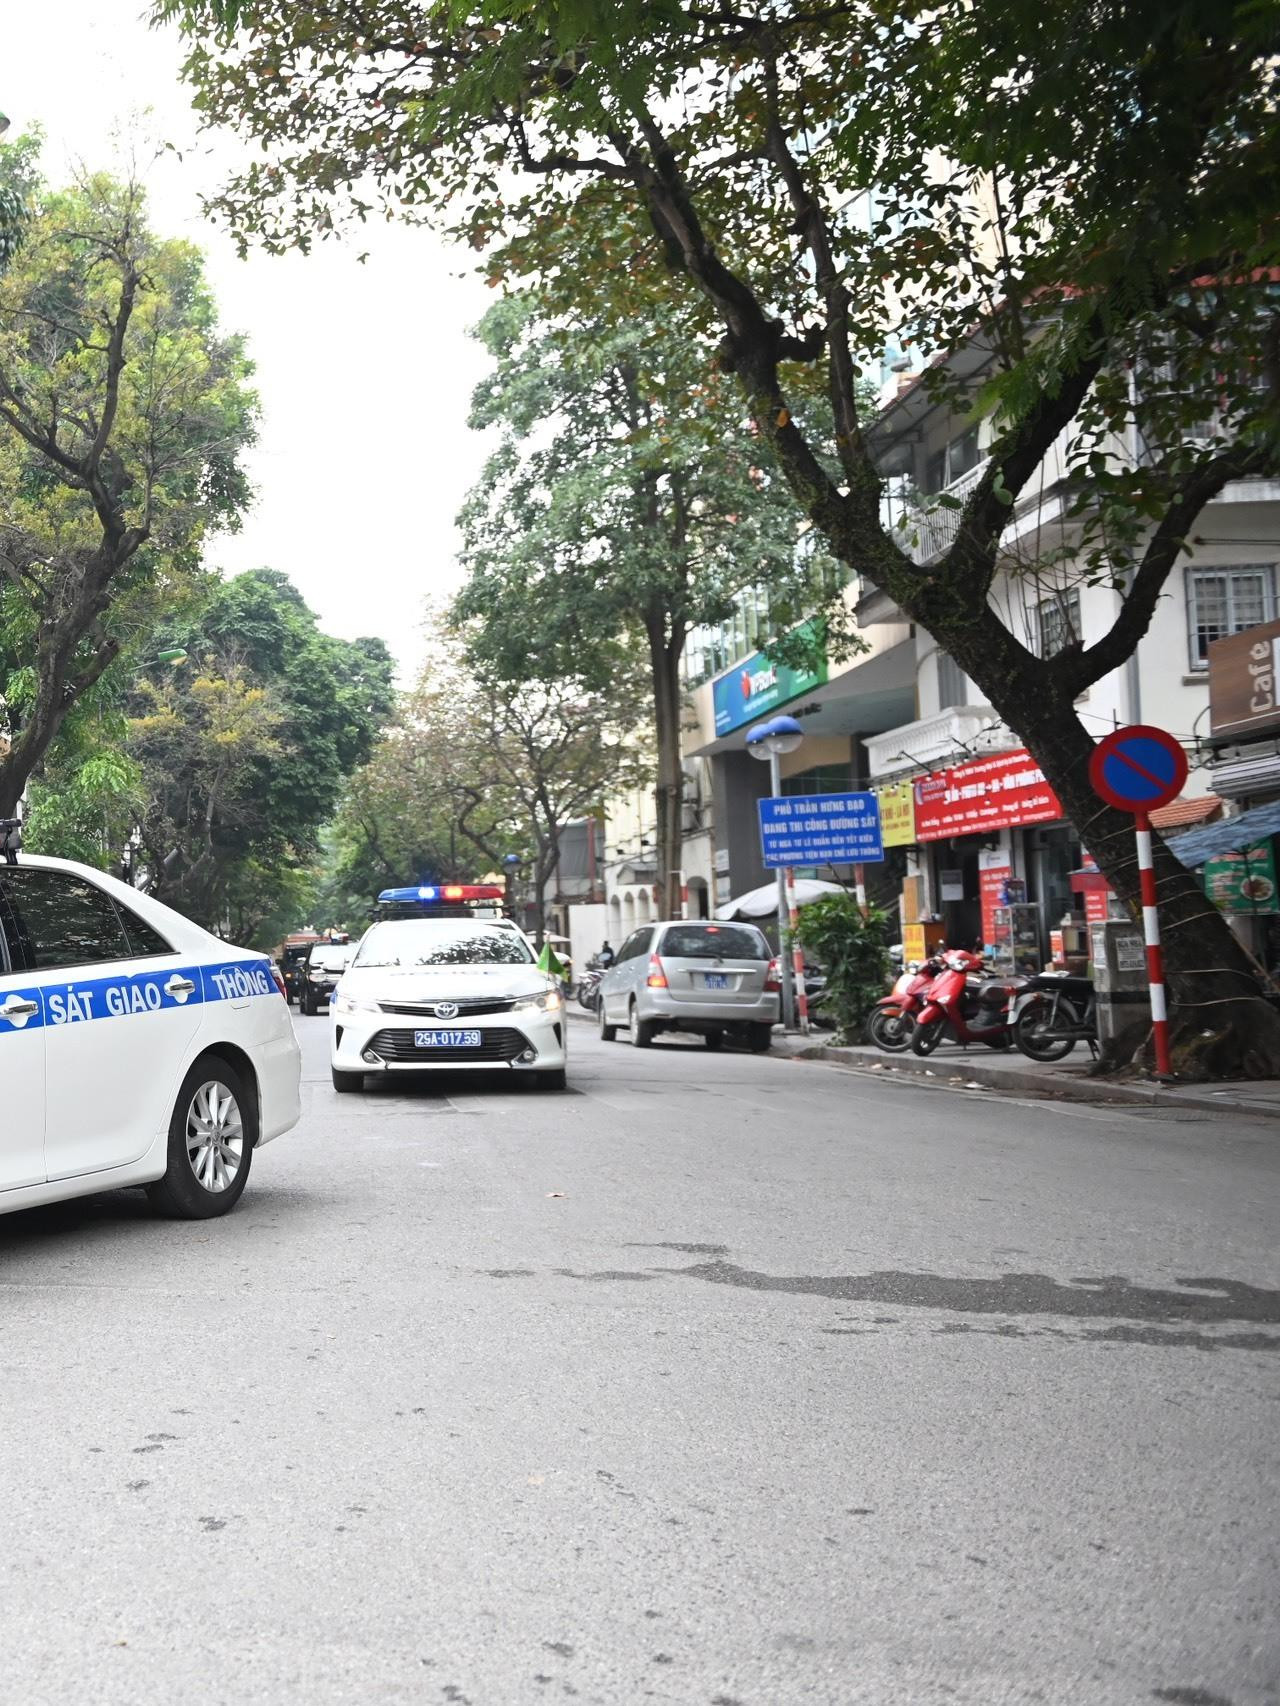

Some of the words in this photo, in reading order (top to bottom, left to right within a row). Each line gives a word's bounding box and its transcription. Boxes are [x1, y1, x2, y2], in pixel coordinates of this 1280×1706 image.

[794, 799, 818, 815] TRẦN
[820, 800, 845, 813] HƯNG
[847, 799, 865, 813] ĐẠO
[789, 821, 803, 833] THI
[805, 818, 828, 832] CÔNG
[49, 985, 94, 1025] SÁT
[106, 982, 162, 1016] GIAO
[211, 968, 270, 1000] THÔNG
[416, 1032, 479, 1046] 29A-017.59
